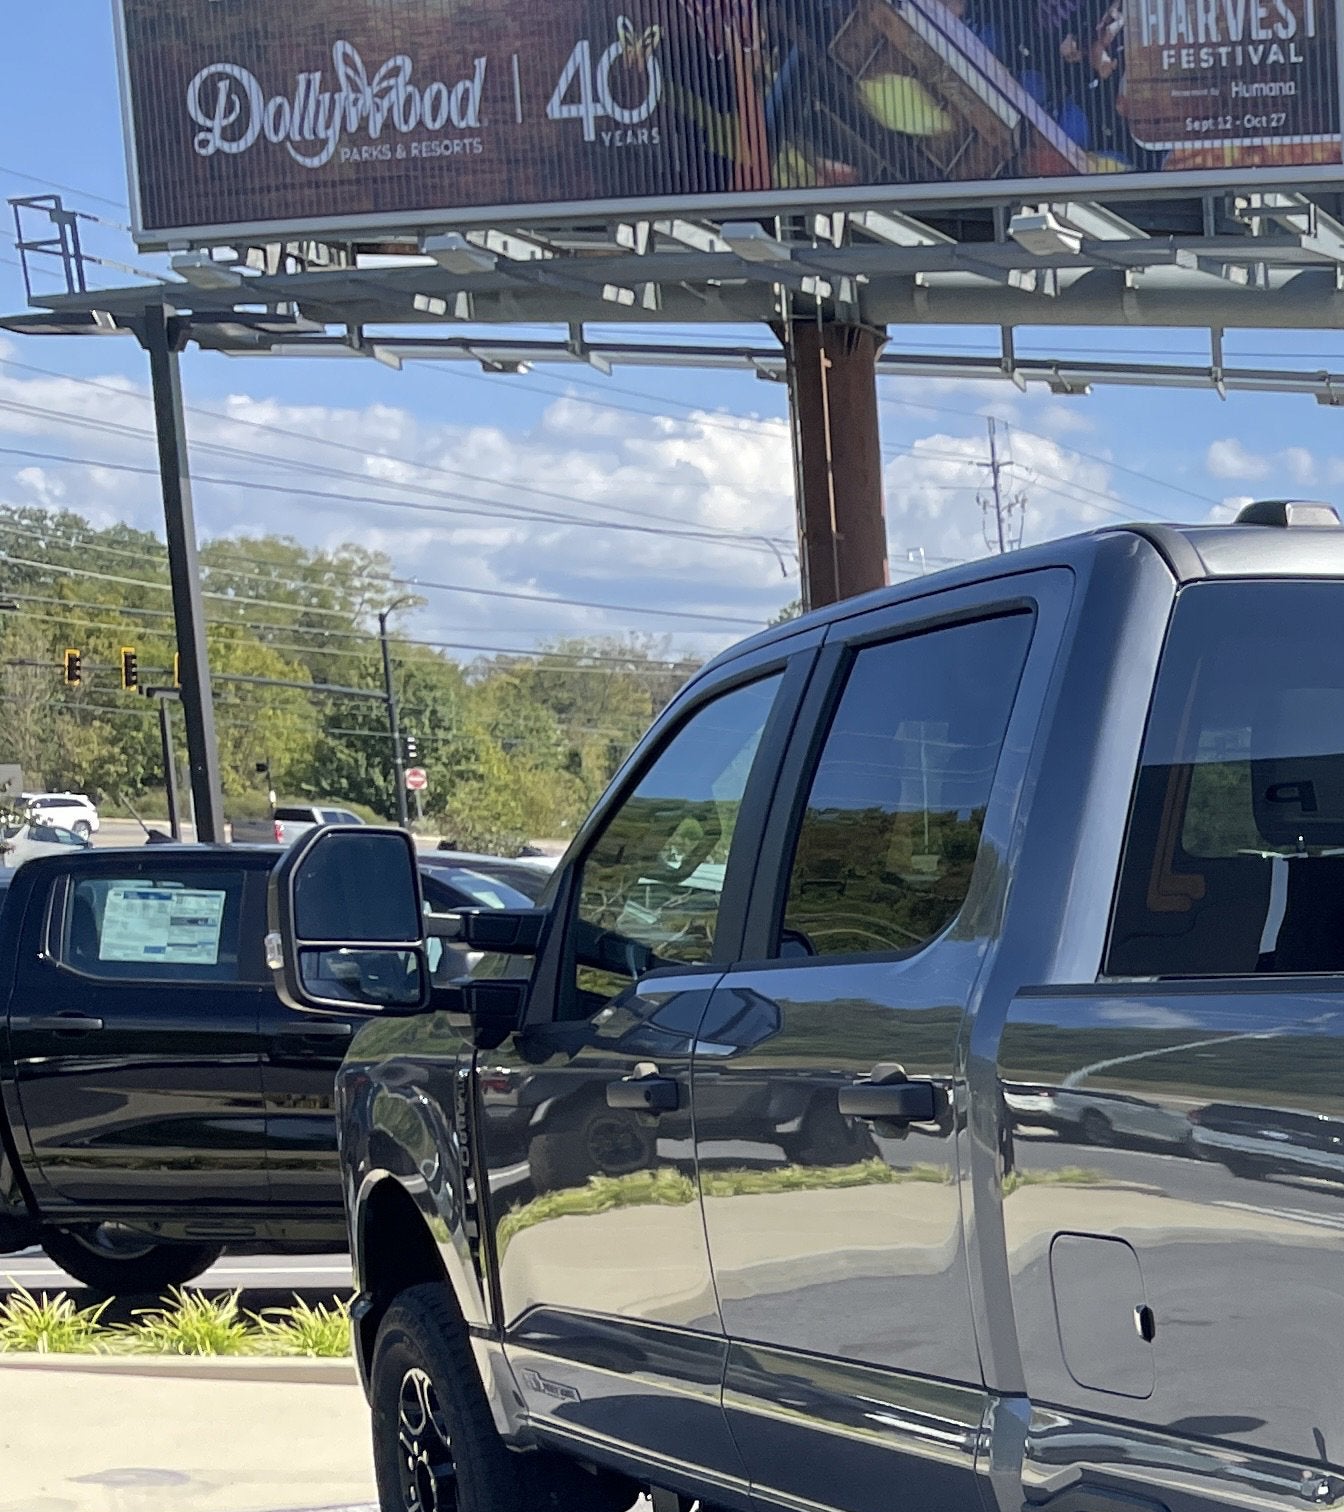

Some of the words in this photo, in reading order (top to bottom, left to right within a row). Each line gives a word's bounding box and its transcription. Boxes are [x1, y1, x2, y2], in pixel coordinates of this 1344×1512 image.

[1141, 0, 1316, 47] HARVEST
[1162, 42, 1304, 70] FESTIVAL
[546, 36, 661, 142] 40
[1231, 81, 1296, 98] Humana
[187, 40, 487, 169] Dollywood
[1185, 117, 1215, 132] Sept
[1217, 115, 1232, 129] 12
[1243, 114, 1267, 128] Oct
[1270, 112, 1287, 127] 27
[340, 144, 391, 163] PARKS
[396, 143, 407, 160] &
[411, 137, 483, 158] RESORTS
[601, 127, 660, 147] YEARS
